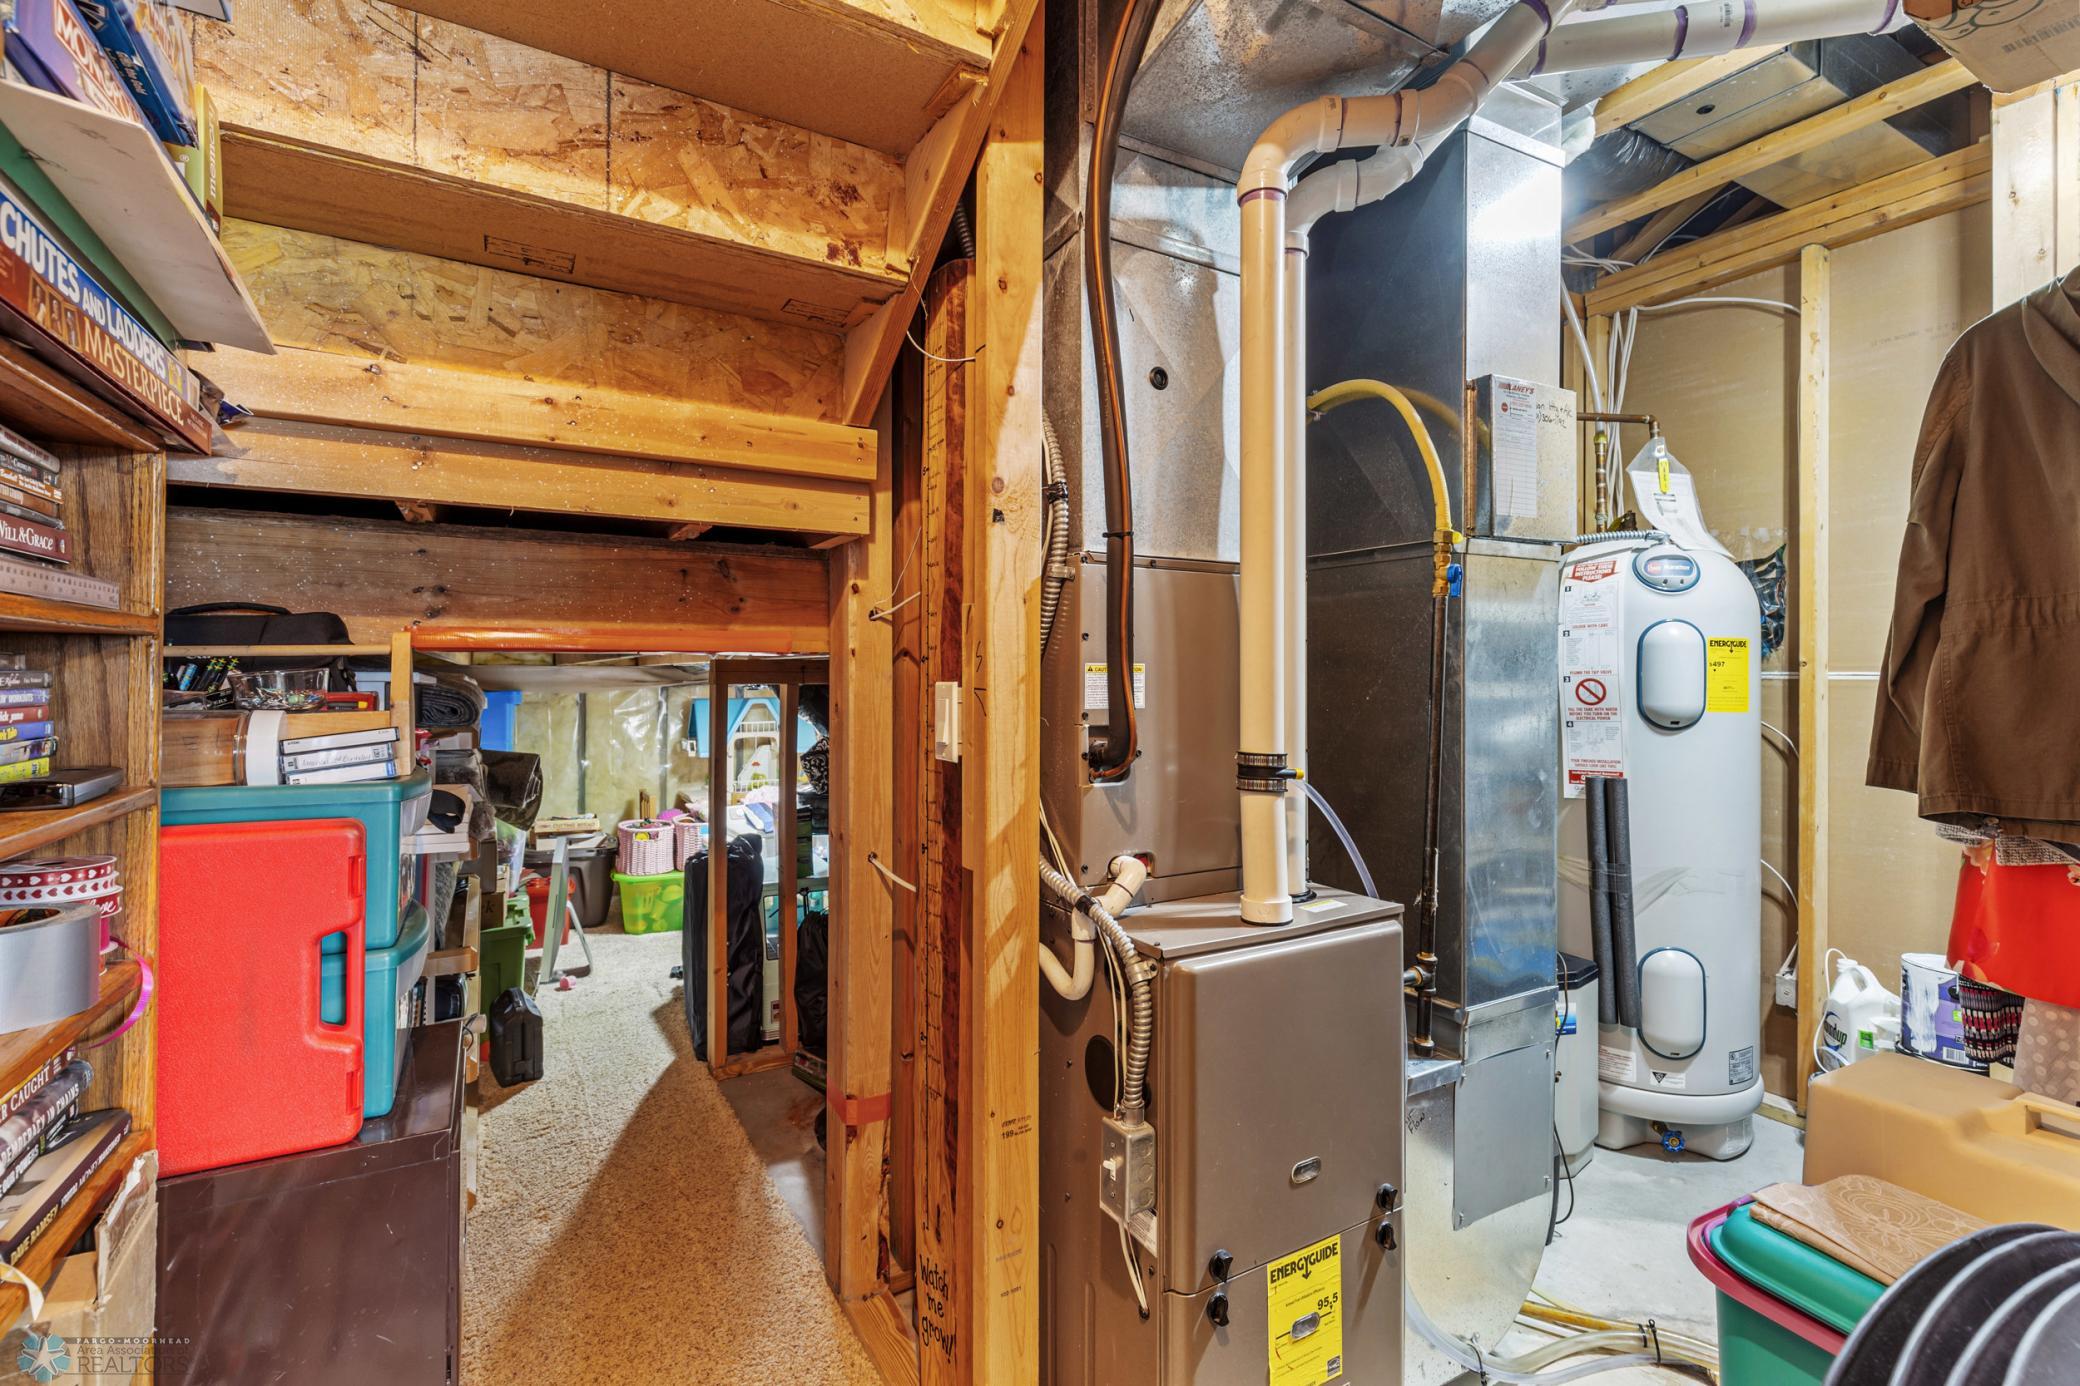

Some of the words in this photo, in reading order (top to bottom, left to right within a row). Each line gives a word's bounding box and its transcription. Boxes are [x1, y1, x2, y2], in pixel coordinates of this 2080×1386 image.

[1, 200, 80, 304] CHUTES
[83, 288, 106, 326] AND
[106, 298, 166, 380] LADDERS
[84, 317, 184, 426] MASTERPIECE
[10, 1066, 50, 1111] CAUGHT
[1, 1116, 46, 1166] DEMOCRACY
[56, 1082, 80, 1116] CHAINS
[30, 1203, 59, 1245] RAMSEY
[919, 1253, 949, 1302] Watch
[1270, 1242, 1339, 1284] ENERGYGUIDE
[926, 1291, 945, 1319] me
[1317, 1291, 1339, 1310] 95.5
[921, 1315, 955, 1365] grow!
